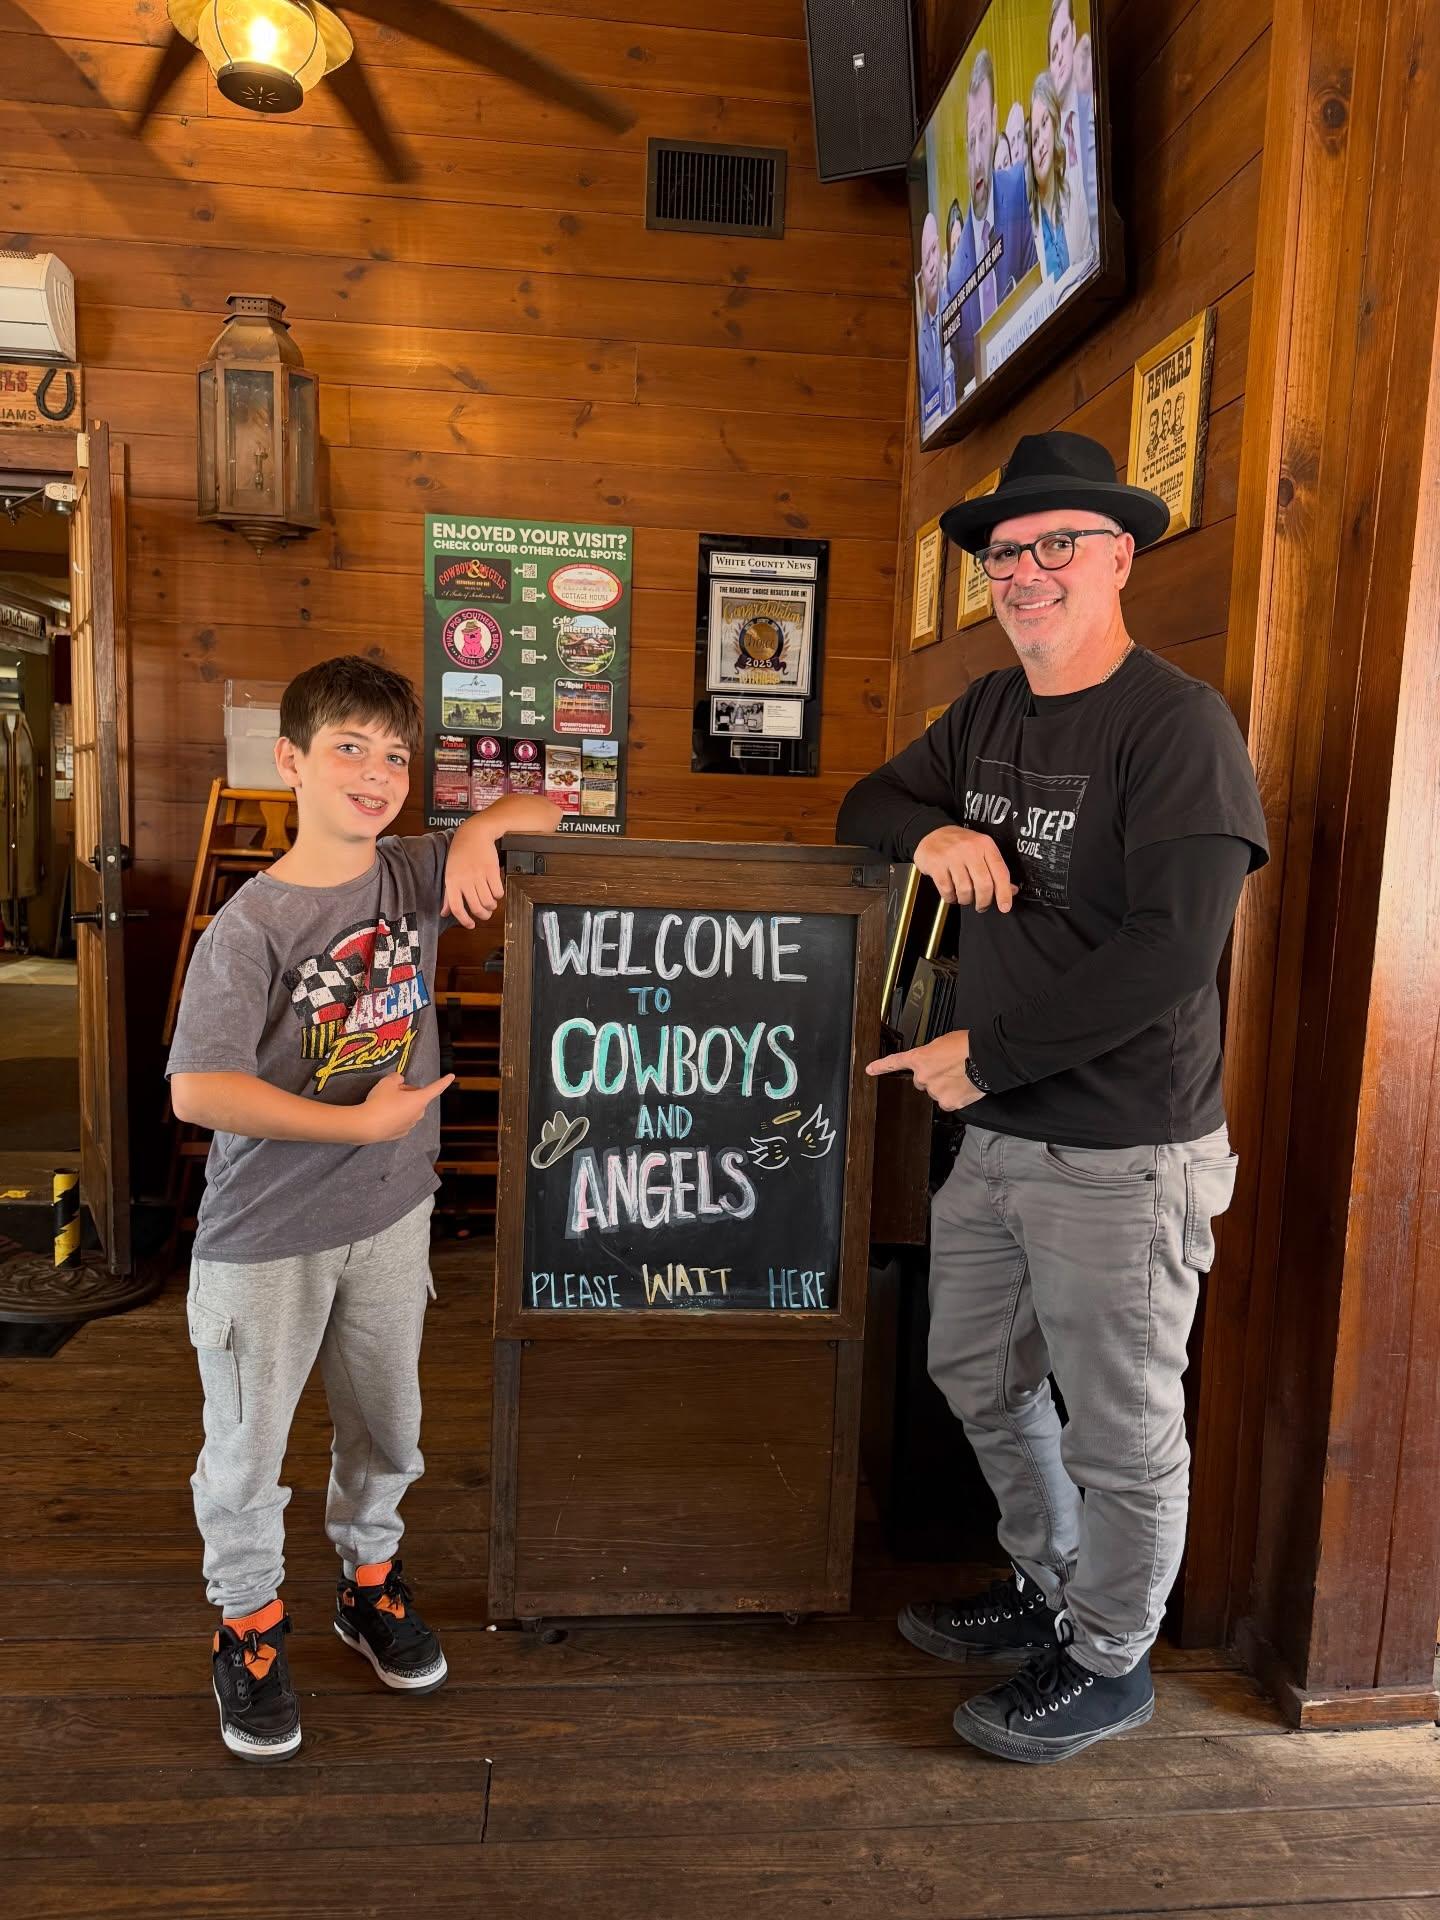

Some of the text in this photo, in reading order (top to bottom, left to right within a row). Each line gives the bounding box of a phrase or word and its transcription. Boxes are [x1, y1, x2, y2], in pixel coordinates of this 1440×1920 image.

[1147, 345, 1192, 403] REWARD
[1142, 442, 1186, 482] YOUNGER
[432, 523, 627, 549] ENJOYED YOUR VISIT?
[433, 540, 626, 561] CHECK OUT OUR OTHER LOCAL SPOTS:
[438, 561, 472, 586] COWBOY
[716, 556, 812, 570] WHITE COUNTY NEWS
[462, 612, 497, 632] SOUTHERN
[553, 616, 571, 625] Cafe
[560, 624, 617, 636] International
[746, 658, 772, 668] 2025
[557, 822, 621, 833] ERTAINMENT
[1020, 806, 1076, 842] STEP
[542, 911, 808, 982] WELCOME
[627, 986, 671, 1015] TO
[316, 1029, 418, 1093] Racing
[551, 1017, 798, 1100] COWBOYS
[634, 1103, 693, 1140] AND
[567, 1147, 757, 1236] ANGELS
[531, 1262, 830, 1309] PLEASE WAIT HERE
